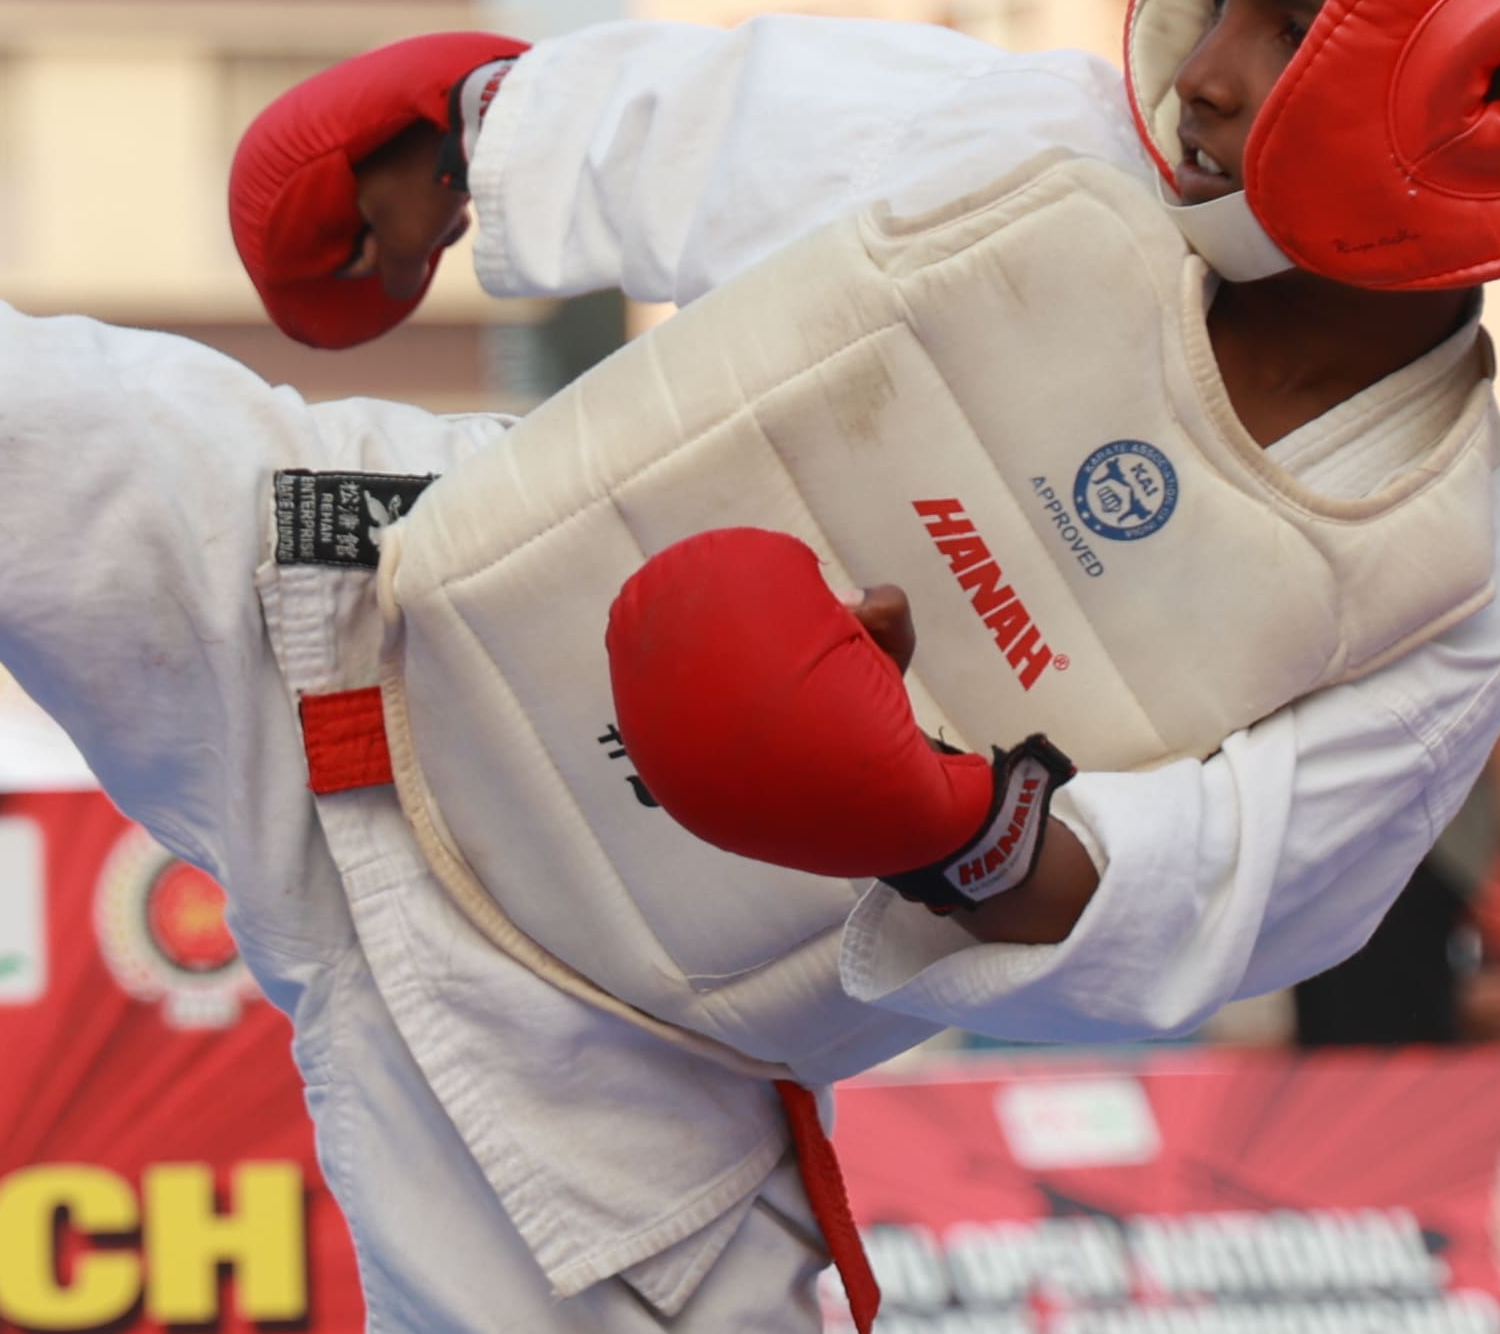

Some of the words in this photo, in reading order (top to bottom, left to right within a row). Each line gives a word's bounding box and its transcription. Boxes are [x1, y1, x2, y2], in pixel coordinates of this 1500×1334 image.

[320, 492, 335, 543] REHAN
[1130, 462, 1159, 497] KAI
[1031, 475, 1105, 579] APPROVED
[957, 778, 1041, 886] HANAH
